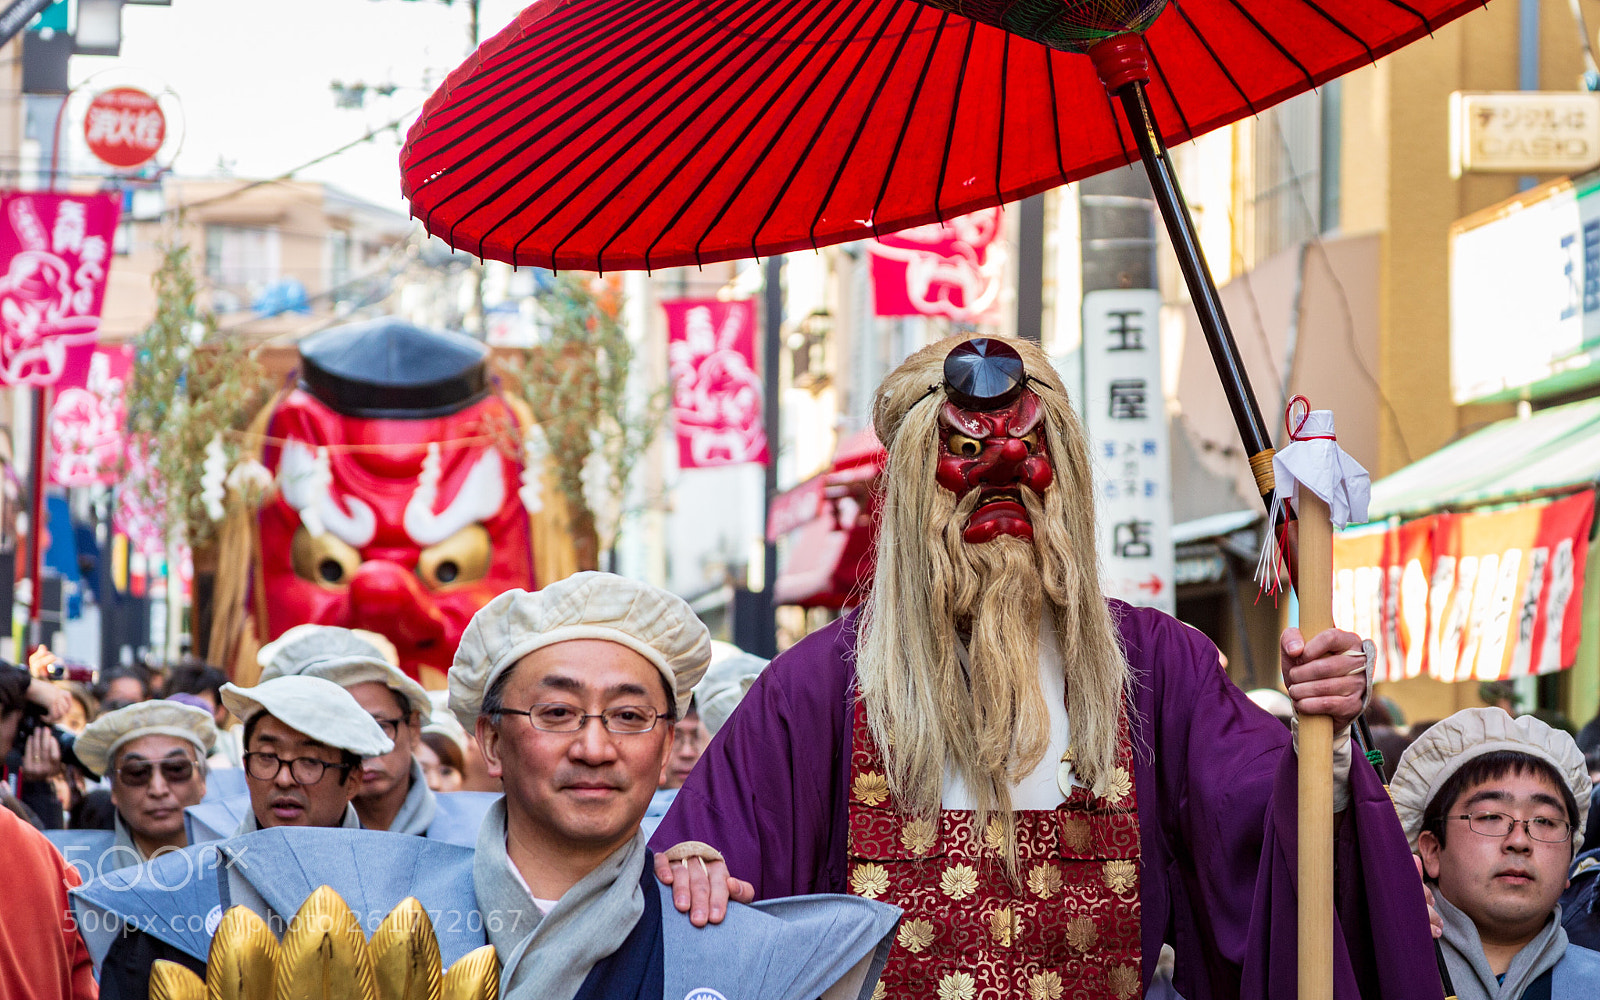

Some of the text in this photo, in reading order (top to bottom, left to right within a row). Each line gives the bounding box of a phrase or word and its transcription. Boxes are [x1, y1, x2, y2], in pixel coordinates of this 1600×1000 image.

[89, 107, 162, 148] 消火栓
[1478, 137, 1588, 157] CASIO
